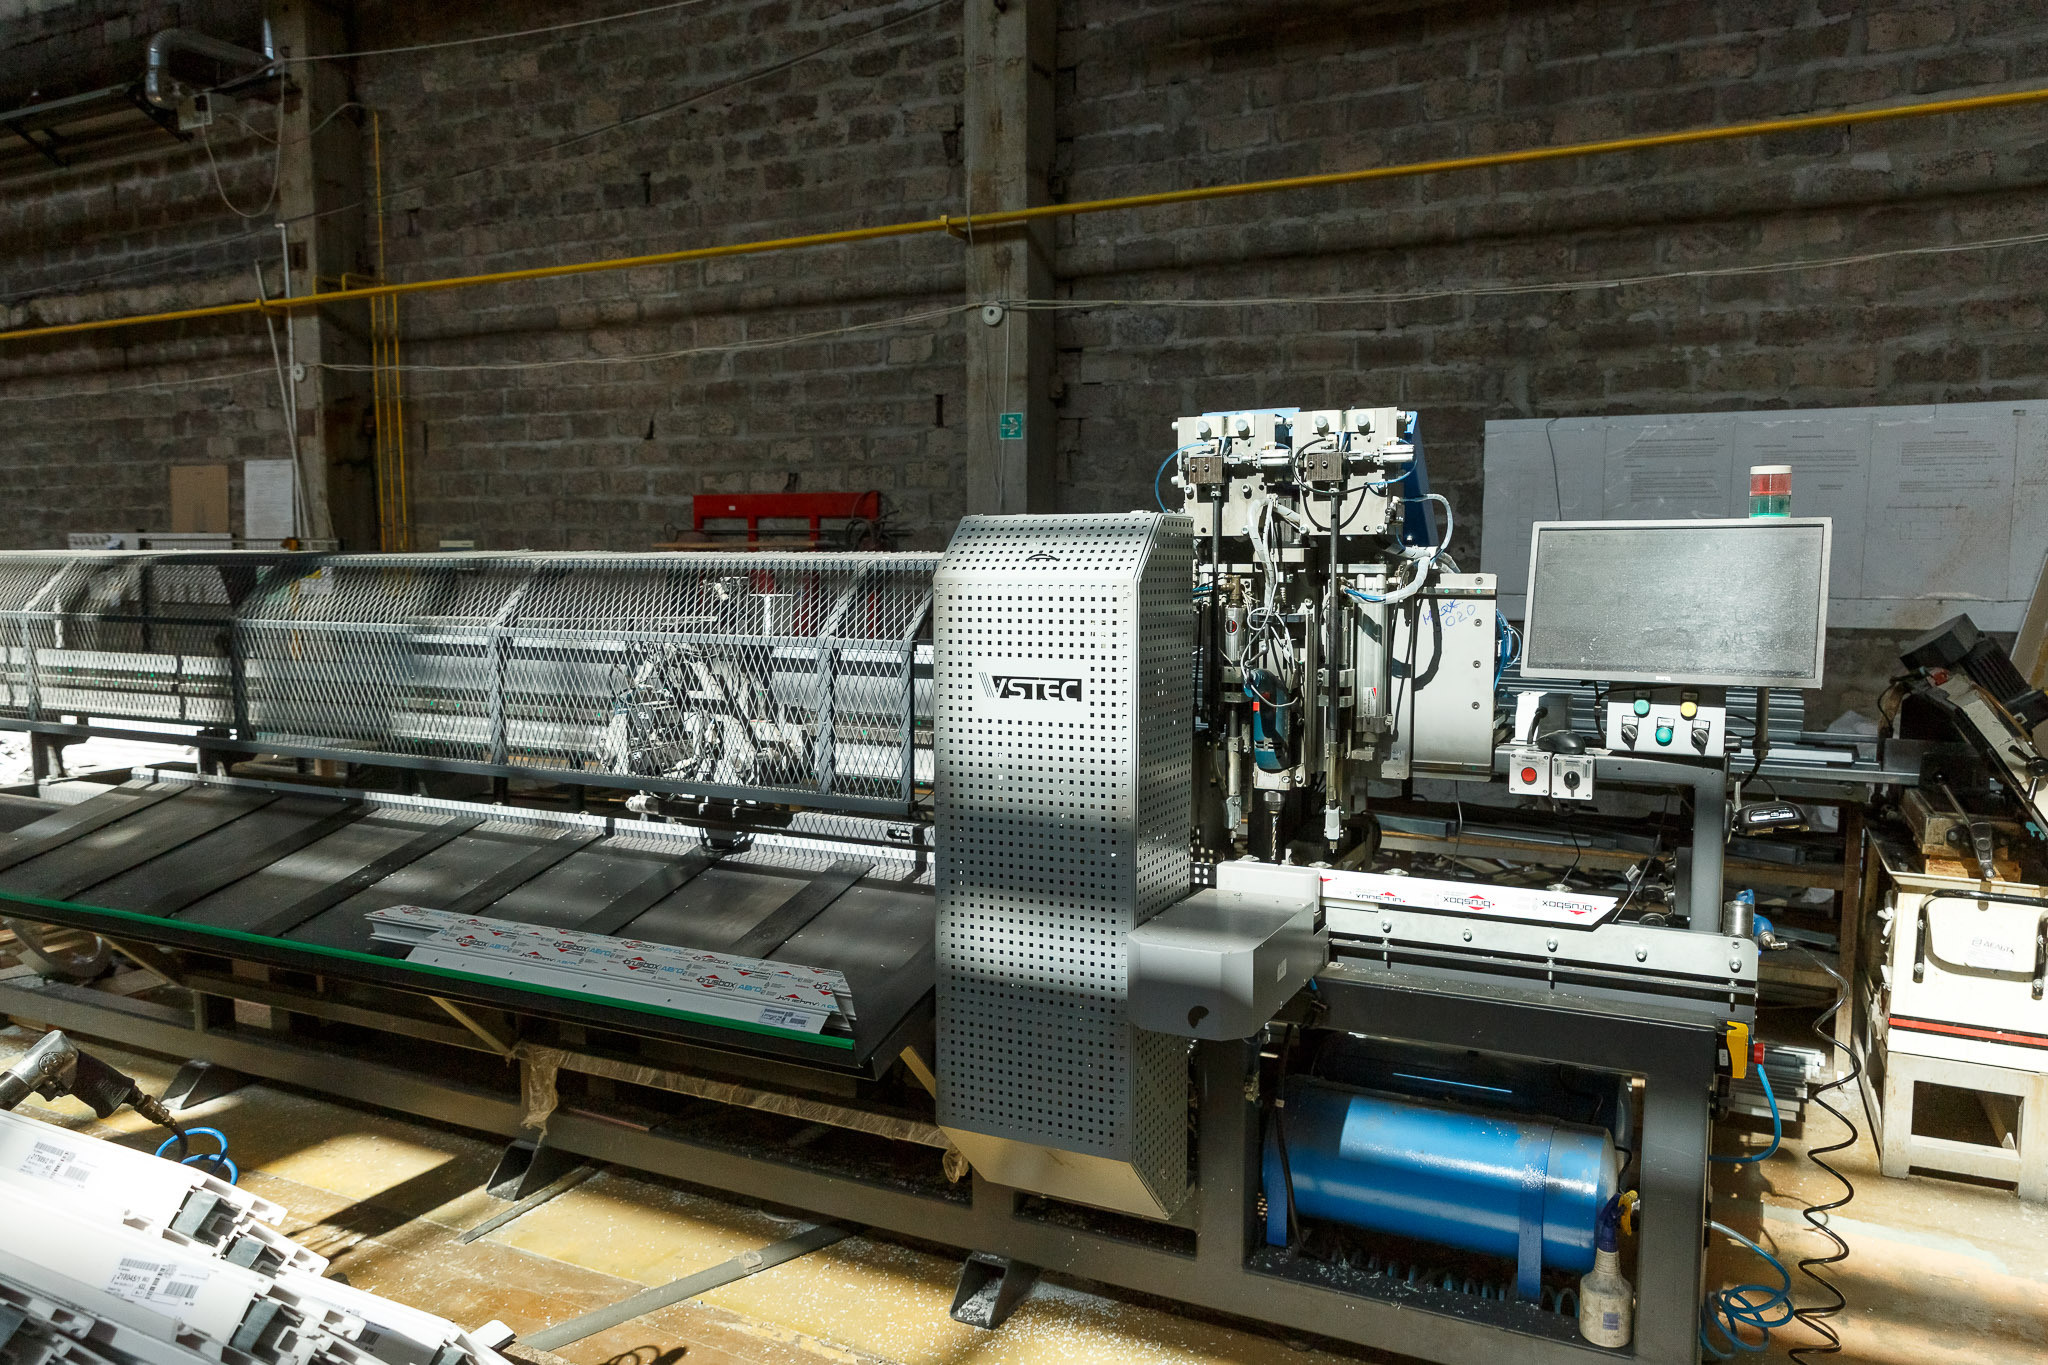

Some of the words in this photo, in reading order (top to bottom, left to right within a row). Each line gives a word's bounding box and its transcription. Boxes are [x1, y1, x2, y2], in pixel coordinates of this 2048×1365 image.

[553, 940, 588, 952] brusbox
[623, 957, 661, 970] brusbox
[696, 975, 737, 989] brusbox
